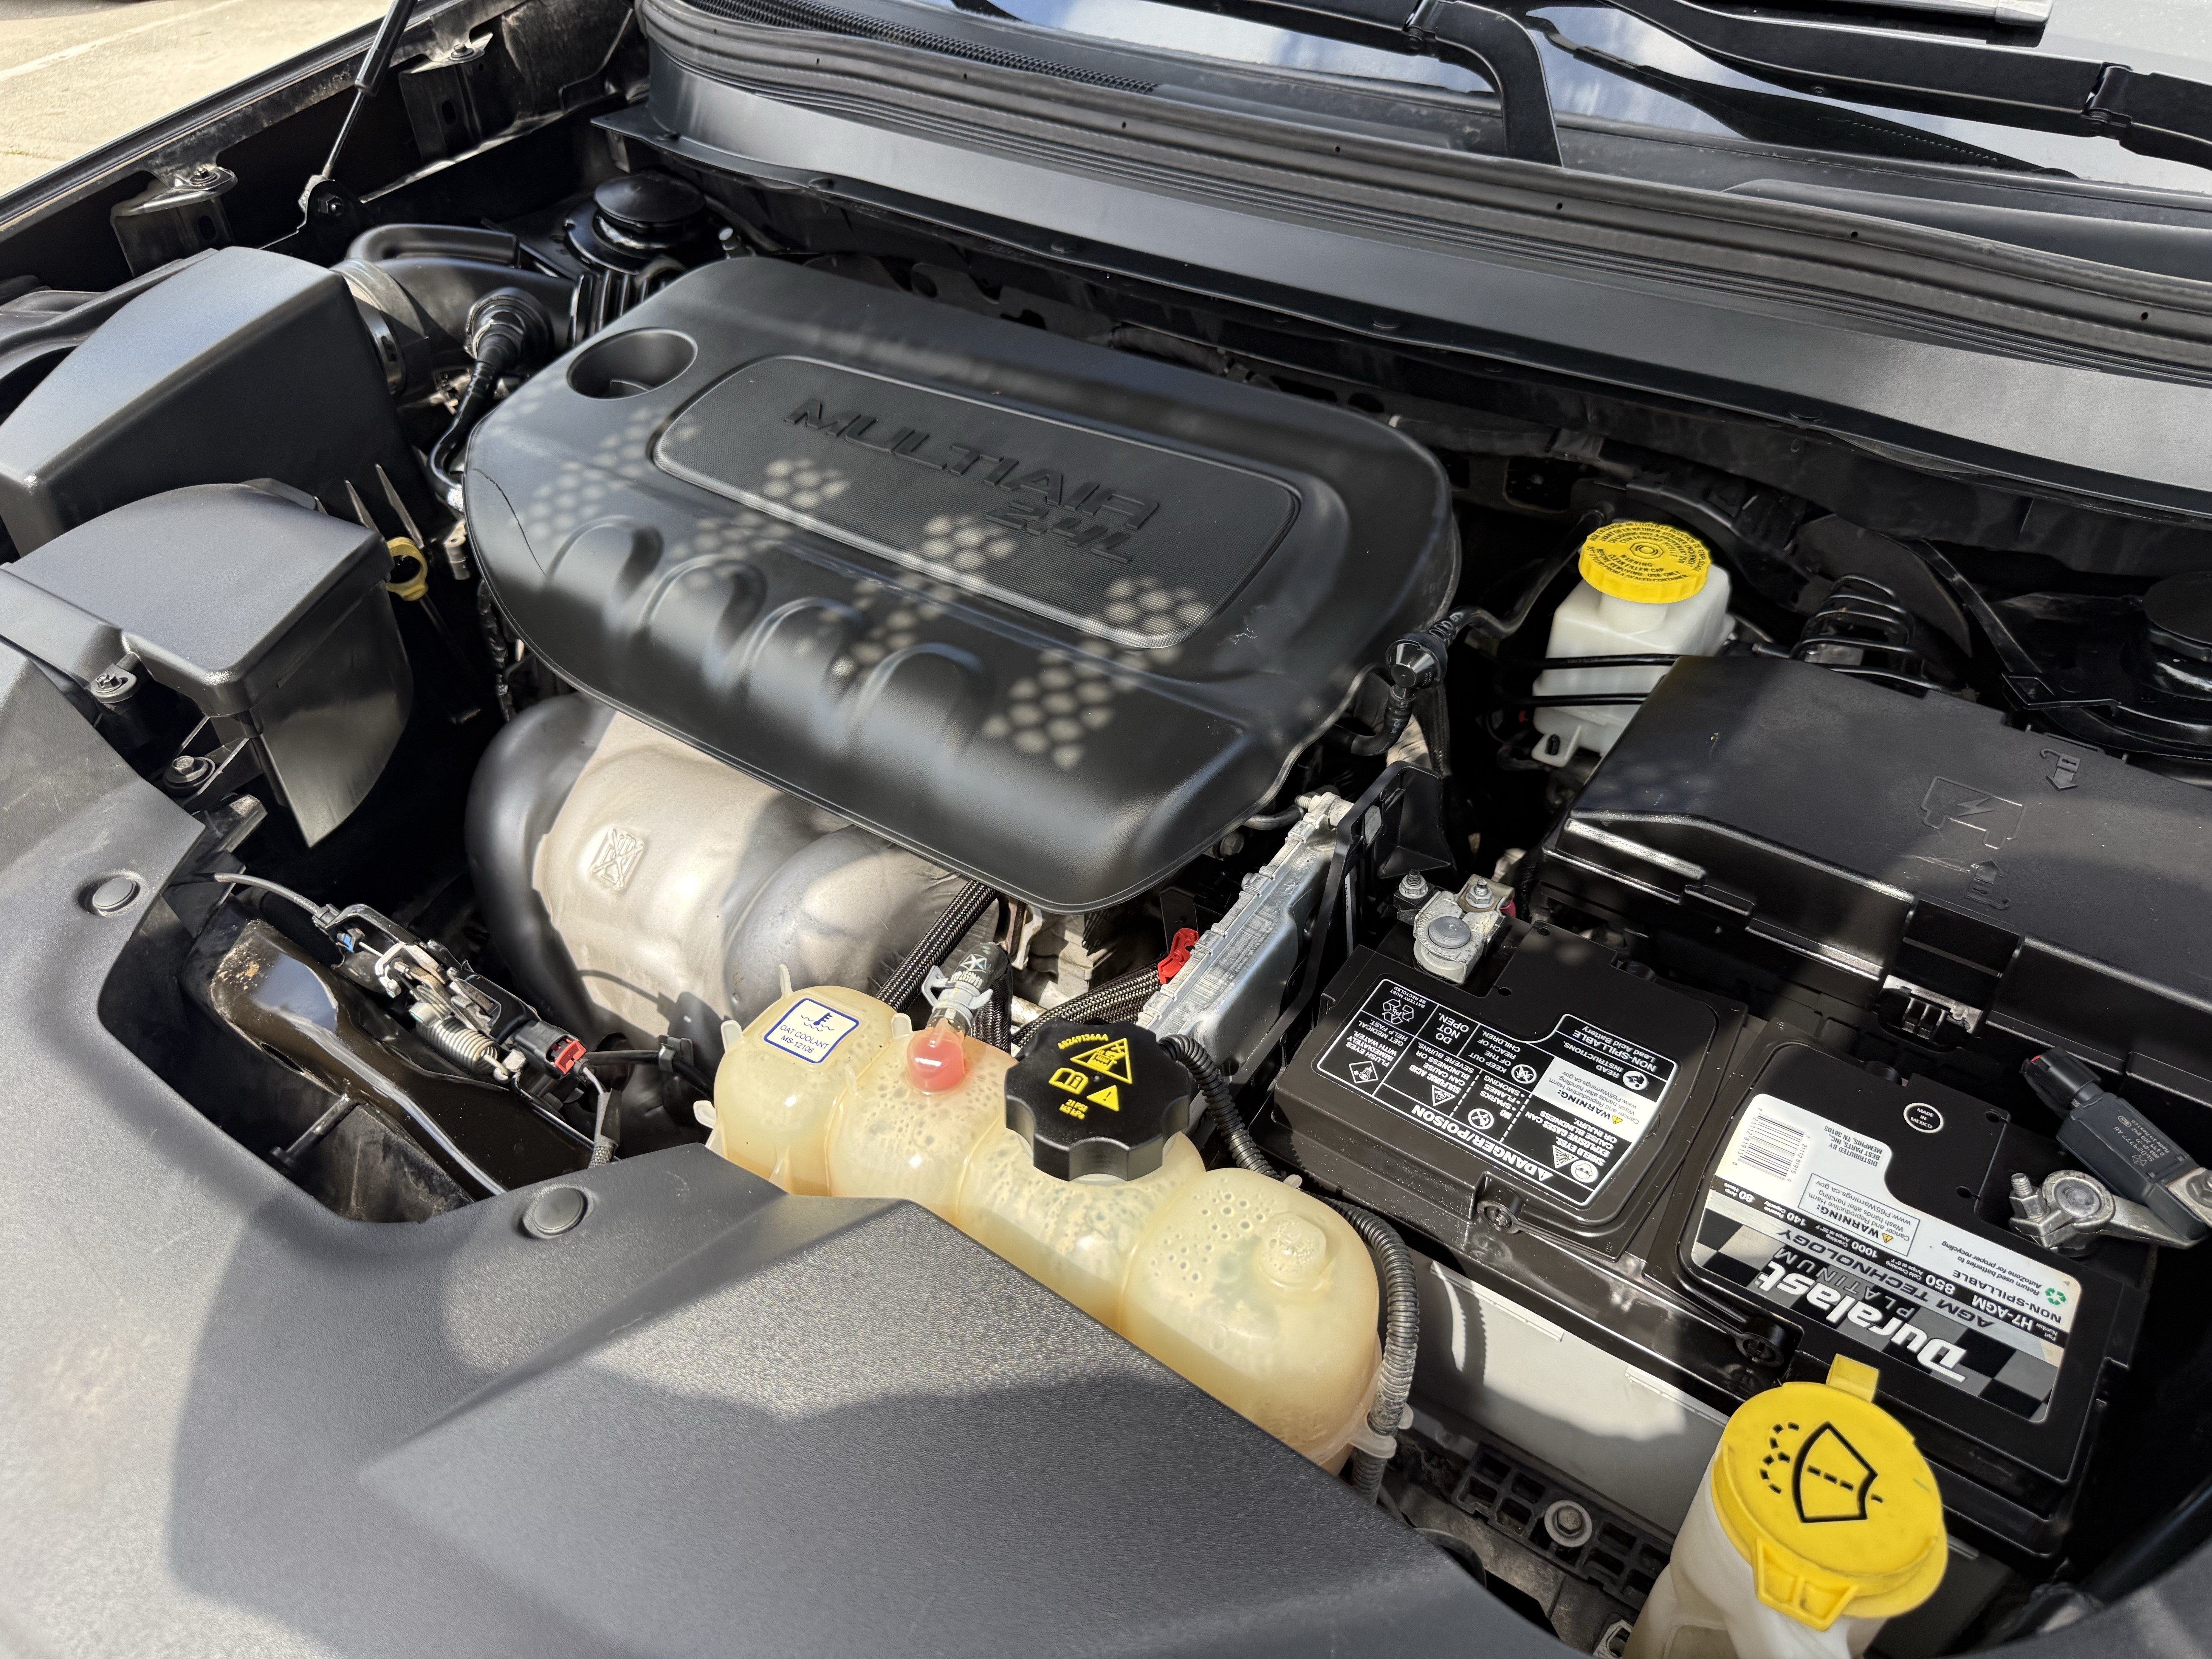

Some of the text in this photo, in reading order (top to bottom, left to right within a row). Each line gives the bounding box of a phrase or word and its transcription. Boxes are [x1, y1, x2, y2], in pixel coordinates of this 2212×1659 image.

[784, 399, 1159, 529] MULTIAIR
[986, 500, 1133, 563] 2.4L
[1403, 996, 1425, 1008] BATTERY
[1369, 1019, 1408, 1042] HELP FAST.
[1436, 1024, 1461, 1039] NOT
[1439, 1013, 1469, 1032] OPEN.
[780, 1025, 830, 1049] OAT COOLANT
[1358, 1020, 1404, 1046] GET MEDICAL
[1435, 1032, 1453, 1044] DO
[1482, 1030, 1521, 1052] CHILDREN.
[780, 1035, 814, 1053] MS-12106
[1346, 1036, 1394, 1062] IMMEDIATELY
[1353, 1030, 1397, 1056] WITH WATER.
[1489, 1043, 1516, 1060] REACH
[1572, 1030, 1657, 1072] NON-SPILLABLE
[1582, 1026, 1656, 1063] Lead Acid Battery
[1345, 1041, 1390, 1067] FLUSH EYES
[1418, 1042, 1474, 1073] SEVERE BURNS.
[1468, 1052, 1507, 1073] KEEP OUT
[1484, 1050, 1499, 1061] THE
[1563, 1041, 1623, 1073] INSTRUCTIONS.
[1415, 1050, 1470, 1080] BLINDNESS OR
[1422, 1062, 1465, 1086] CAN CAUSE
[1595, 1065, 1620, 1078] READ
[1409, 1064, 1462, 1094] SULFURIC ACID
[1483, 1075, 1520, 1096] SMOKING
[1480, 1090, 1512, 1109] SPARKS
[1484, 1084, 1516, 1103] FLAMES
[1566, 1087, 1604, 1108] Reproductive
[1584, 1089, 1599, 1097] after
[1598, 1094, 1617, 1107] hands
[1074, 1102, 1088, 1112] PSI
[1557, 1089, 1610, 1120] WARNING:
[1604, 1104, 1617, 1113] and
[1618, 1104, 1635, 1116] Wash
[1917, 1108, 1934, 1117] MADE
[1499, 1109, 1513, 1120] NO
[1617, 1111, 1639, 1125] Cancer
[1910, 1117, 1932, 1128] MEXICO
[1525, 1111, 1611, 1158] EXPLOSIVE GASES CAN
[1539, 1110, 1614, 1150] CAUSE BLINDNESS
[1573, 1118, 1618, 1144] OR INJURY.
[1824, 1126, 1843, 1138] 38103
[2131, 1120, 2150, 1136] Mexico
[1411, 1104, 1538, 1175] DANGER/POISON
[1843, 1140, 1864, 1154] PARTS,
[1853, 1137, 1882, 1154] MEMPHIS,
[2156, 1141, 2170, 1153] Made
[1555, 1136, 1606, 1166] SHIELD EYES.
[1838, 1147, 1878, 1167] DISTRIBUTED
[1863, 1150, 1881, 1161] BEST
[1724, 1182, 1739, 1193] Hours
[1724, 1188, 1737, 1197] Amp
[1738, 1191, 1755, 1203] 80
[1827, 1202, 1870, 1224] Reproductive
[1847, 1203, 1862, 1212] after
[1863, 1210, 1884, 1223] hands
[1786, 1212, 1806, 1226] 140
[1816, 1204, 1879, 1238] WARNING:
[1871, 1221, 1885, 1230] and
[1884, 1219, 1903, 1233] Wash
[1825, 1233, 1848, 1247] Cranking
[1885, 1228, 1910, 1242] Cancer
[1851, 1241, 1877, 1258] 1000
[1941, 1240, 1972, 1258] recycling
[1885, 1260, 1922, 1280] Cold Cranking
[1966, 1260, 1996, 1277] batteries
[1972, 1255, 1997, 1268] proper
[1772, 1244, 1915, 1321] PLATINUM
[1778, 1230, 1994, 1328] AGM TECHNOLOGY
[1925, 1274, 1955, 1295] 850
[1996, 1273, 2014, 1284] used
[2008, 1270, 2042, 1289] AutoZone
[1952, 1269, 2061, 1324] NON-SPILLABLE
[2015, 1281, 2040, 1296] Return
[1754, 1261, 1966, 1382] Duralast
[1972, 1295, 2033, 1331] H7-AGM
[2035, 1323, 2057, 1336] Number
[2044, 1332, 2056, 1341] Part
